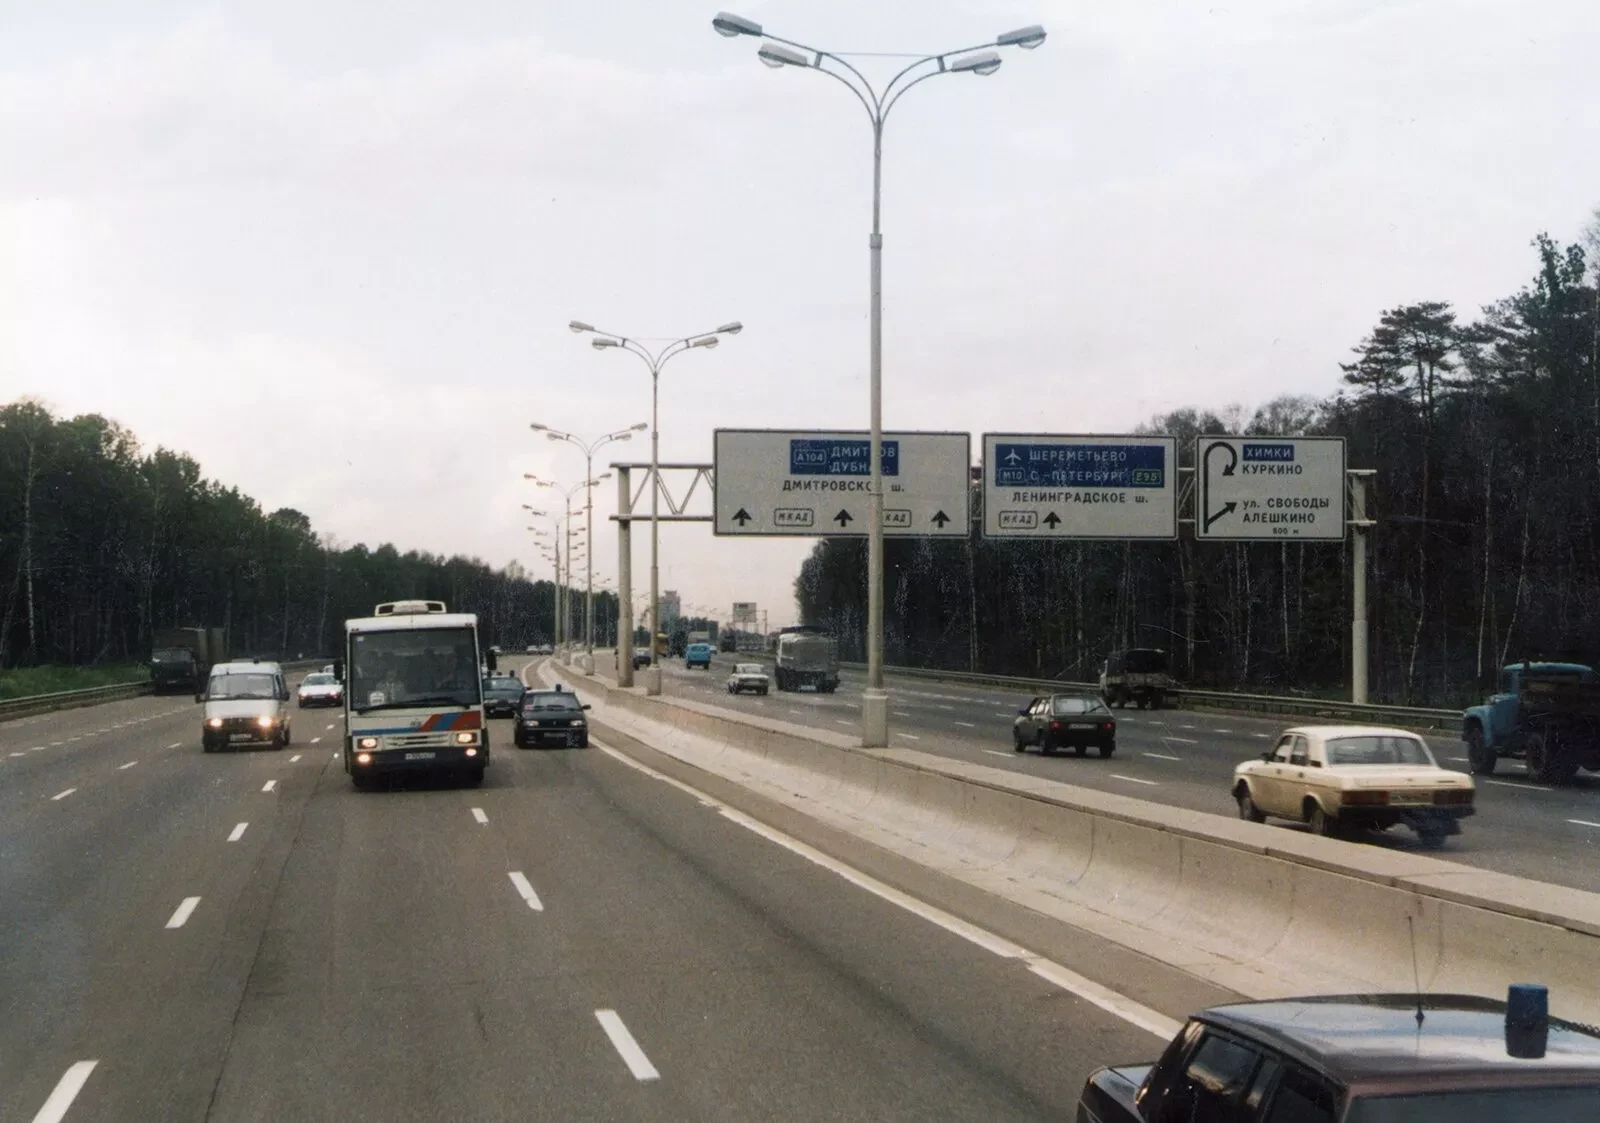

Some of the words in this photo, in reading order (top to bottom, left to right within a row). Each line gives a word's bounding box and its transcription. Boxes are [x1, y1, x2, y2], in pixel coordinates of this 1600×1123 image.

[831, 446, 895, 457] ДМИТОВ
[1029, 450, 1127, 461] ШЕРЕМЕТЬЕВО
[1246, 447, 1292, 458] ХИМКИ
[797, 453, 823, 462] А104
[831, 461, 871, 472] ДУБН
[1242, 464, 1303, 475] КУРКИНО
[1003, 471, 1022, 480] М10
[783, 480, 872, 492] ДМИТРОВСКО
[1012, 491, 1126, 504] ЛЕНИНГРАДСКОЕ
[1135, 495, 1149, 503] ш.
[1243, 500, 1261, 510] ул.
[1267, 498, 1329, 509] СВОБОДЫ
[779, 513, 808, 521] МКАД
[885, 514, 906, 522] КАД
[1003, 515, 1032, 524] МКАД
[1243, 513, 1316, 524] АЛЕШКИНО
